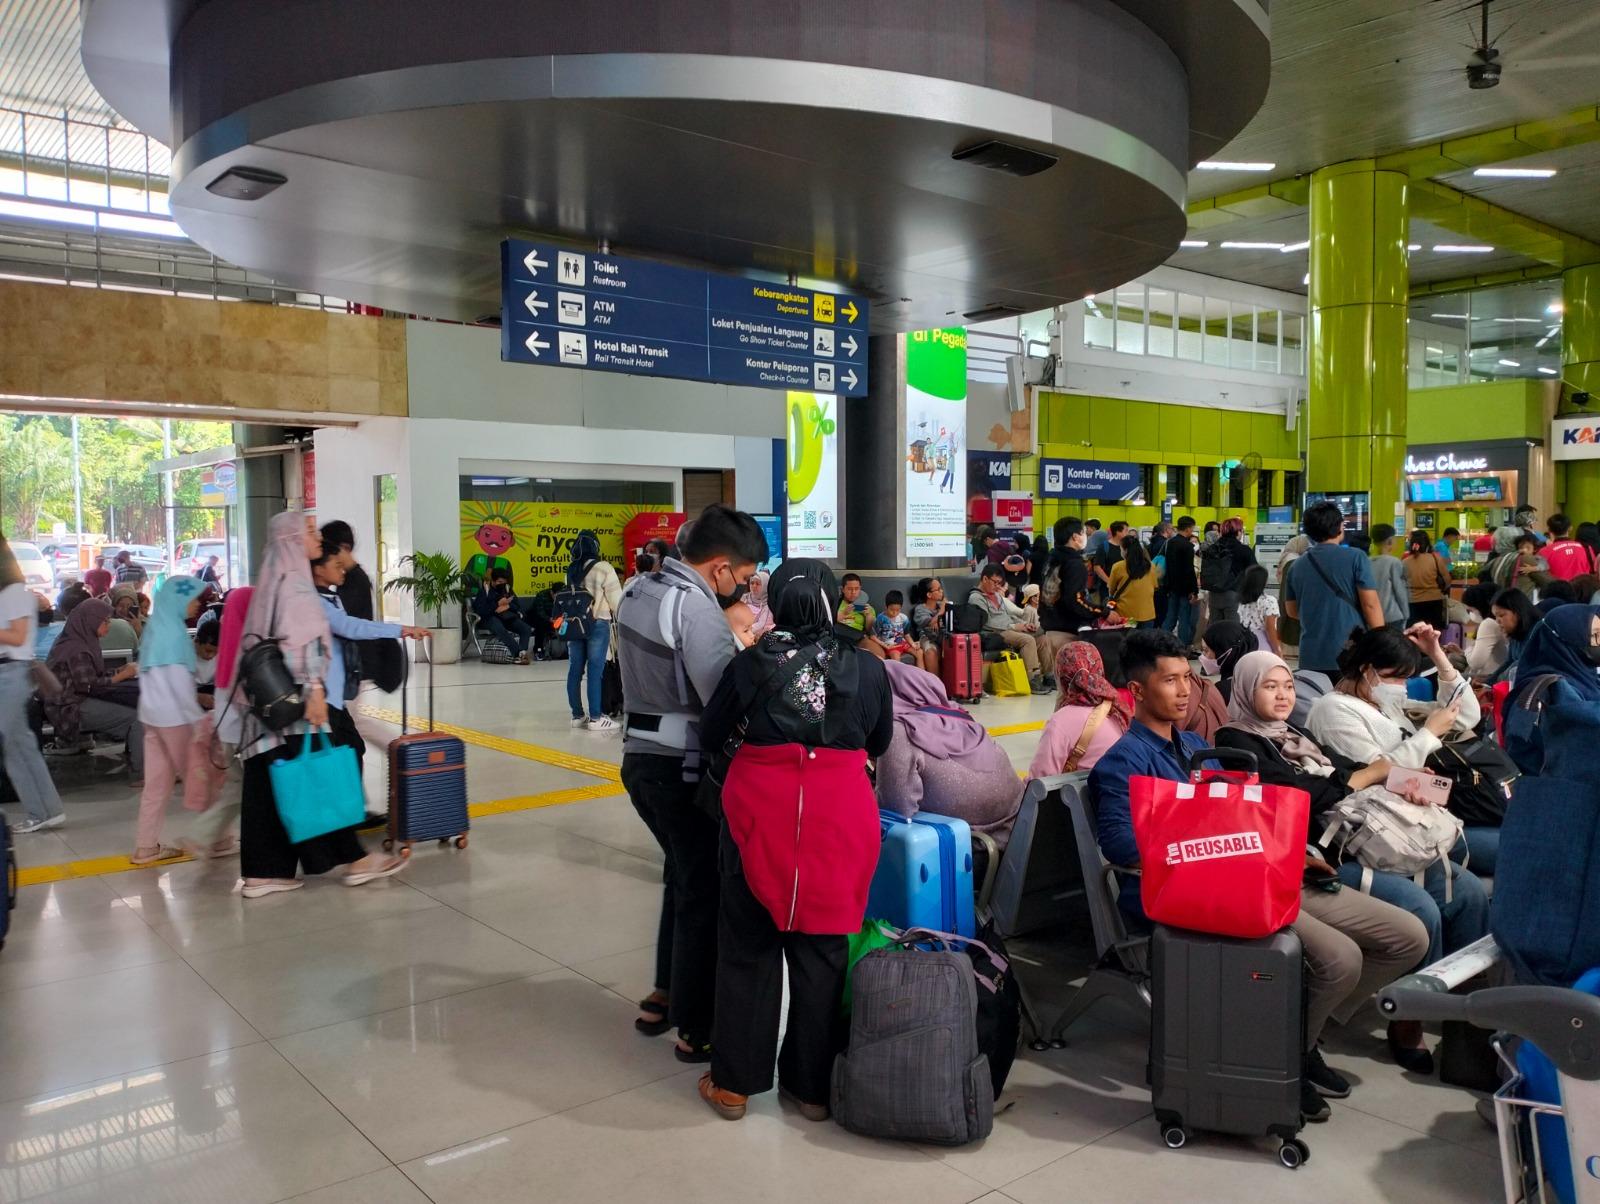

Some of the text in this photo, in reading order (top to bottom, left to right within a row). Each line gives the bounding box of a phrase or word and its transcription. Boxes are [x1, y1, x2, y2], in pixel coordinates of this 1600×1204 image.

[593, 260, 619, 274] Toilet
[592, 275, 627, 288] Restroom
[753, 287, 809, 303] Keberangkatan
[593, 300, 616, 313] ATM
[777, 303, 809, 315] Departures
[593, 315, 612, 325] ATM
[712, 317, 809, 339] Loket Penjualan Langsung
[594, 339, 669, 358] Hotel Rail Transit
[739, 334, 809, 350] Go Show Ticket Counter
[594, 353, 655, 368] Rail Transit Hotel
[746, 358, 809, 374] Konter Pelaporan
[759, 372, 809, 385] Check-in Counter
[989, 461, 1011, 477] KAI
[1405, 454, 1435, 473] hez
[1067, 467, 1130, 483] Konter Pelaporan
[1067, 482, 1103, 491] Check-in Counter
[530, 563, 568, 577] gratis
[530, 581, 546, 589] Pos
[1184, 835, 1259, 858] REUSABLE
